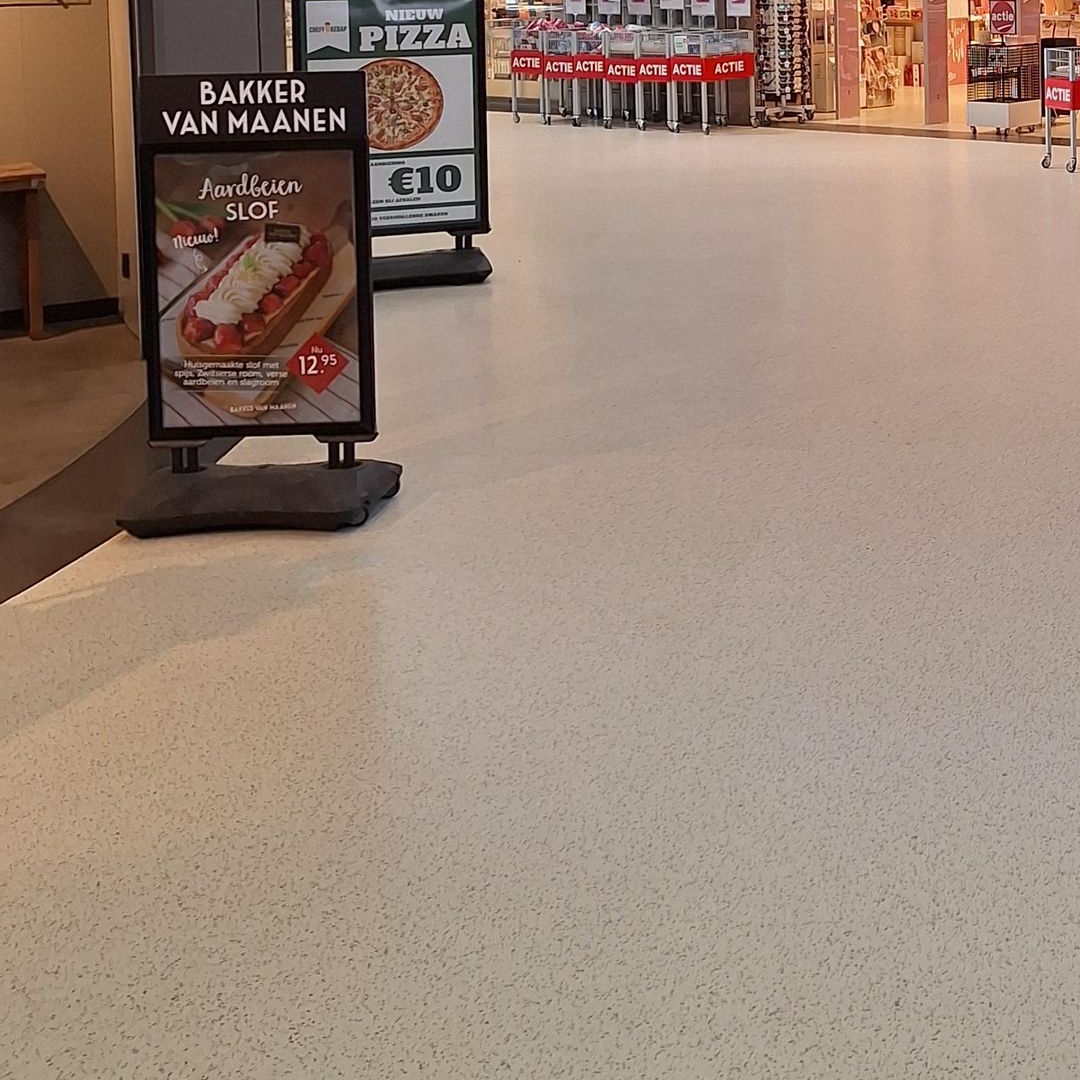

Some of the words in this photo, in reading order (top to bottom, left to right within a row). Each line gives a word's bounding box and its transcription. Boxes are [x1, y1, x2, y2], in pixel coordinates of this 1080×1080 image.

[384, 8, 445, 21] NIEUW
[991, 11, 1014, 22] actie
[358, 23, 473, 52] PIZZA
[512, 57, 541, 69] ACTIE
[545, 61, 573, 73] ACTIE
[576, 60, 604, 72] ACTIE
[639, 63, 668, 76] ACTIE
[672, 63, 702, 76] ACTIE
[714, 60, 745, 74] ACTIE
[607, 63, 636, 77] ACTIE
[200, 79, 306, 105] BAKKER
[1045, 87, 1071, 102] ACTIE
[162, 110, 219, 136] VAN
[228, 107, 346, 134] MAANEN
[197, 172, 303, 201] Aardbeien
[387, 164, 462, 196] €10
[225, 200, 279, 221] SLOF
[310, 345, 323, 355] Nu
[183, 360, 244, 371] Huisgemaakte
[245, 360, 262, 369] slof
[262, 361, 279, 369] met
[196, 370, 238, 378] Zwitserse
[266, 370, 289, 378] verse
[183, 377, 225, 386] aardbeien
[239, 378, 279, 388] slagroom
